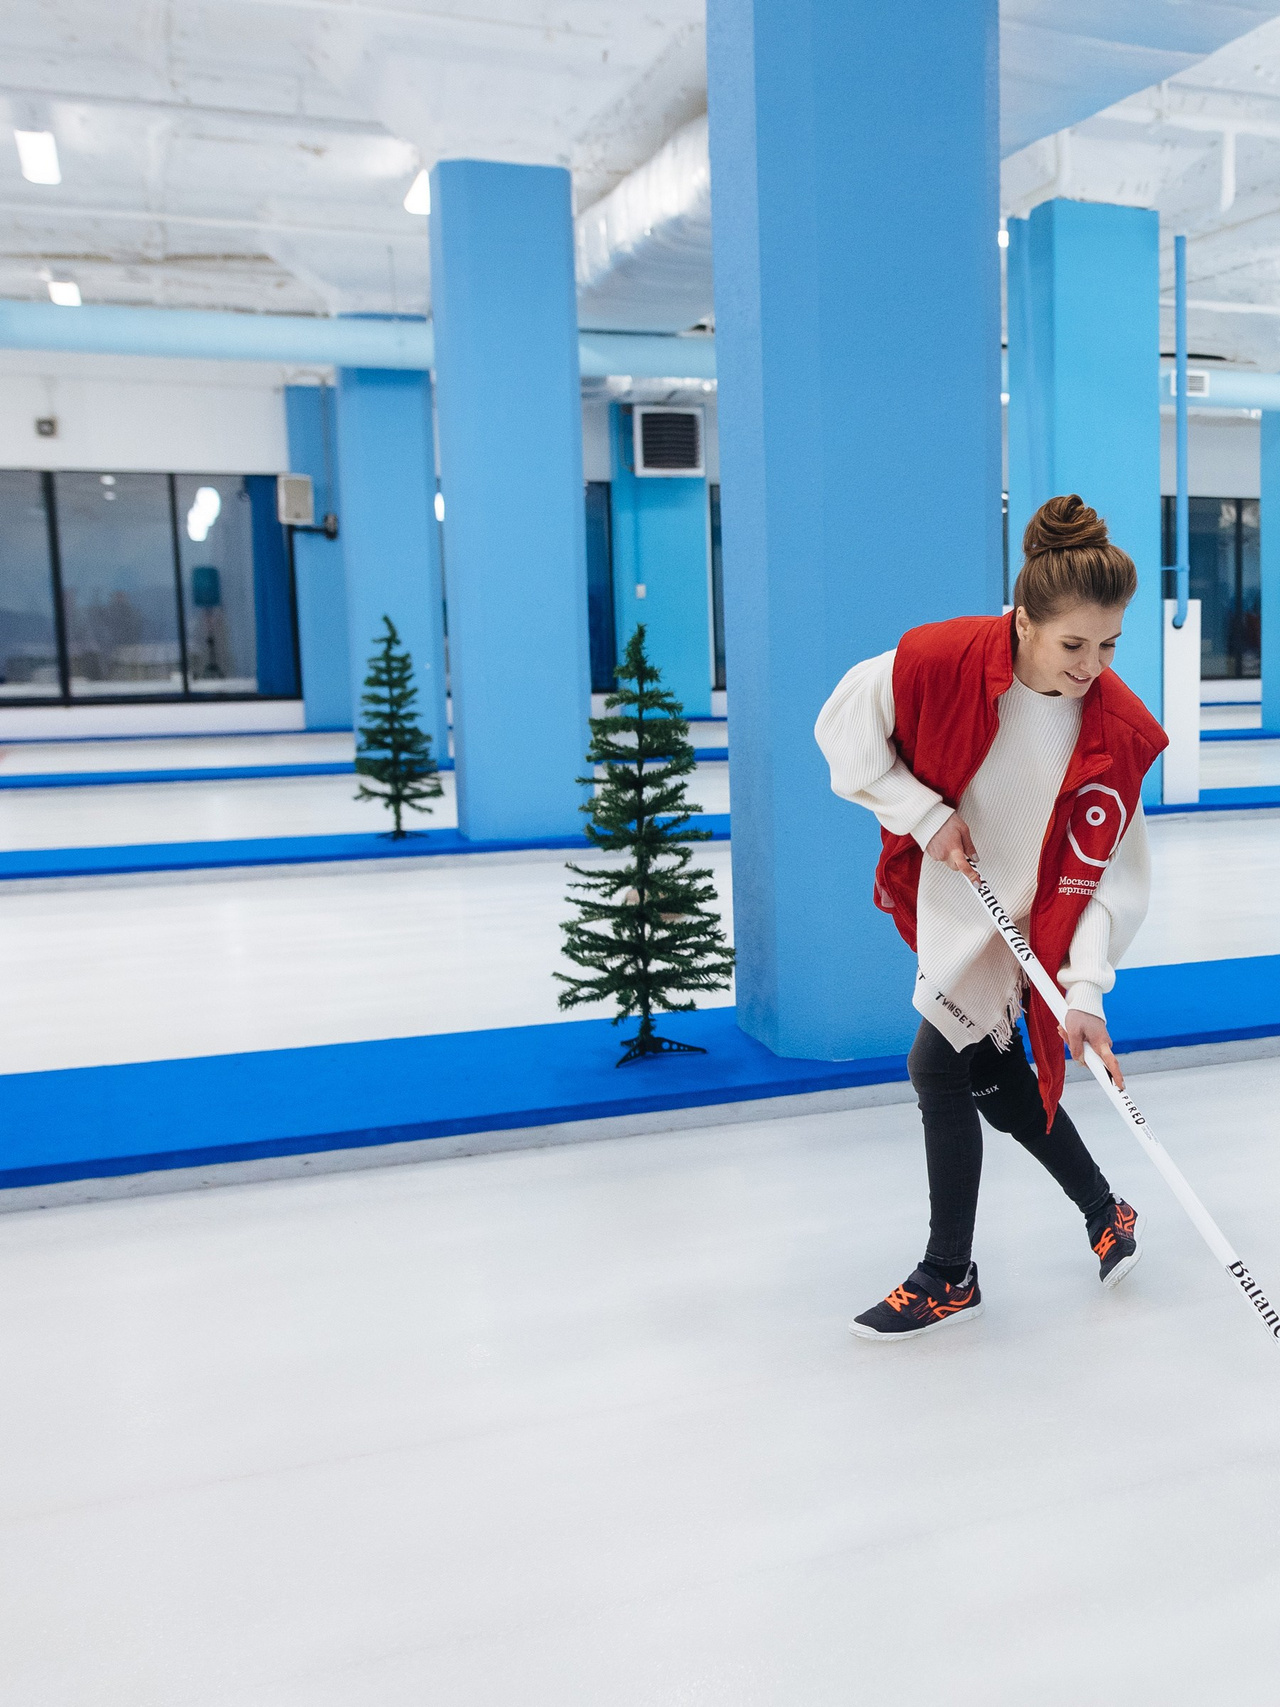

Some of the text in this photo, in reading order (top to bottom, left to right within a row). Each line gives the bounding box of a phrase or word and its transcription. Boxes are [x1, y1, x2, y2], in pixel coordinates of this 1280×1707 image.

[966, 857, 1035, 962] ancePlus
[935, 991, 976, 1029] TWINSET
[1117, 1088, 1146, 1125] PERED
